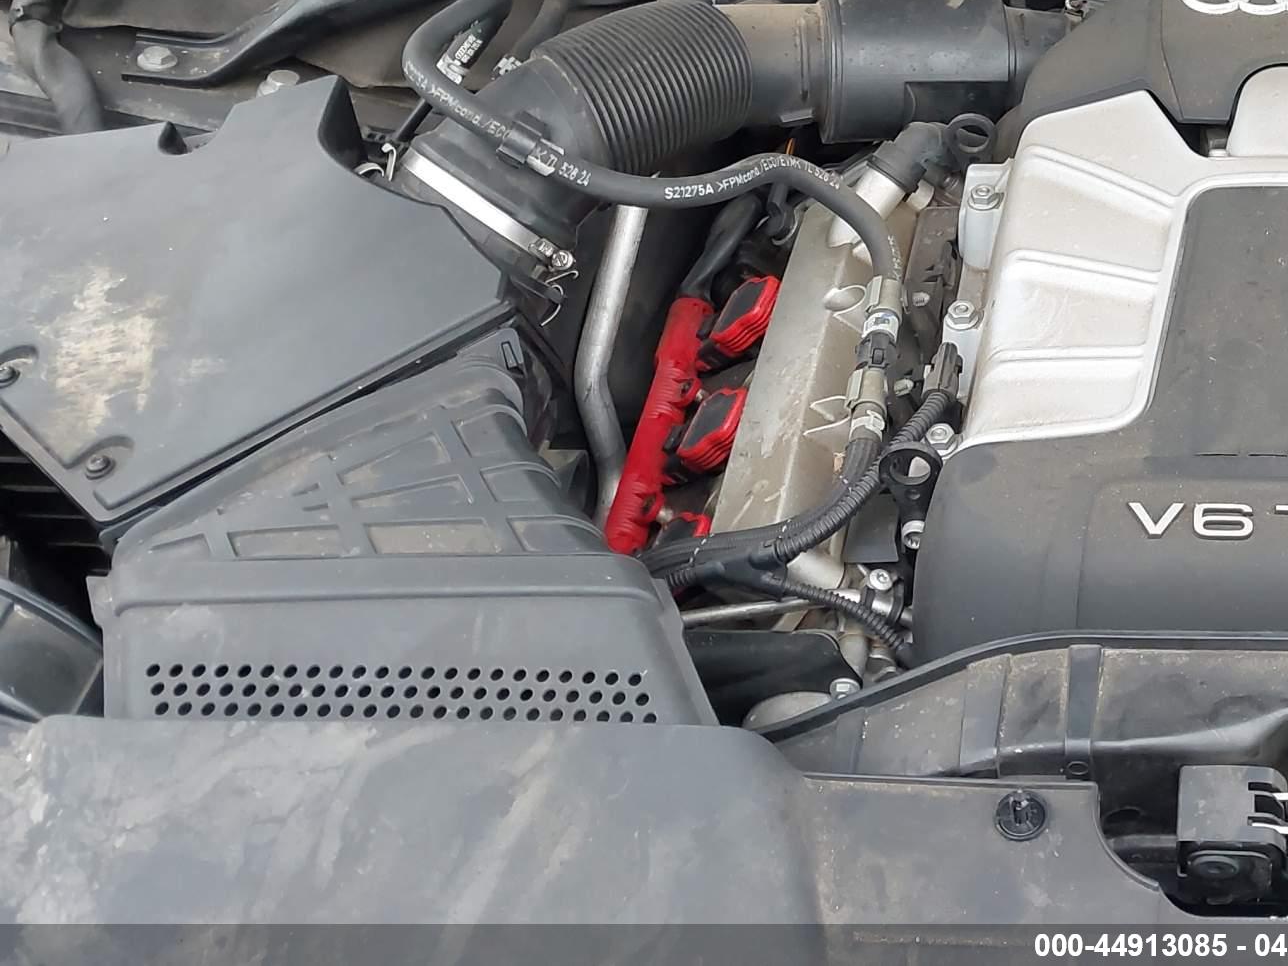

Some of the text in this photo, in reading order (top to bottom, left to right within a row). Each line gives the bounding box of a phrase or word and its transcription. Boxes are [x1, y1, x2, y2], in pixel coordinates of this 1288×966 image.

[558, 161, 576, 181] 528
[576, 171, 592, 187] 24
[664, 184, 715, 200] S21275A
[813, 166, 829, 183] 528
[1128, 501, 1254, 540] V6
